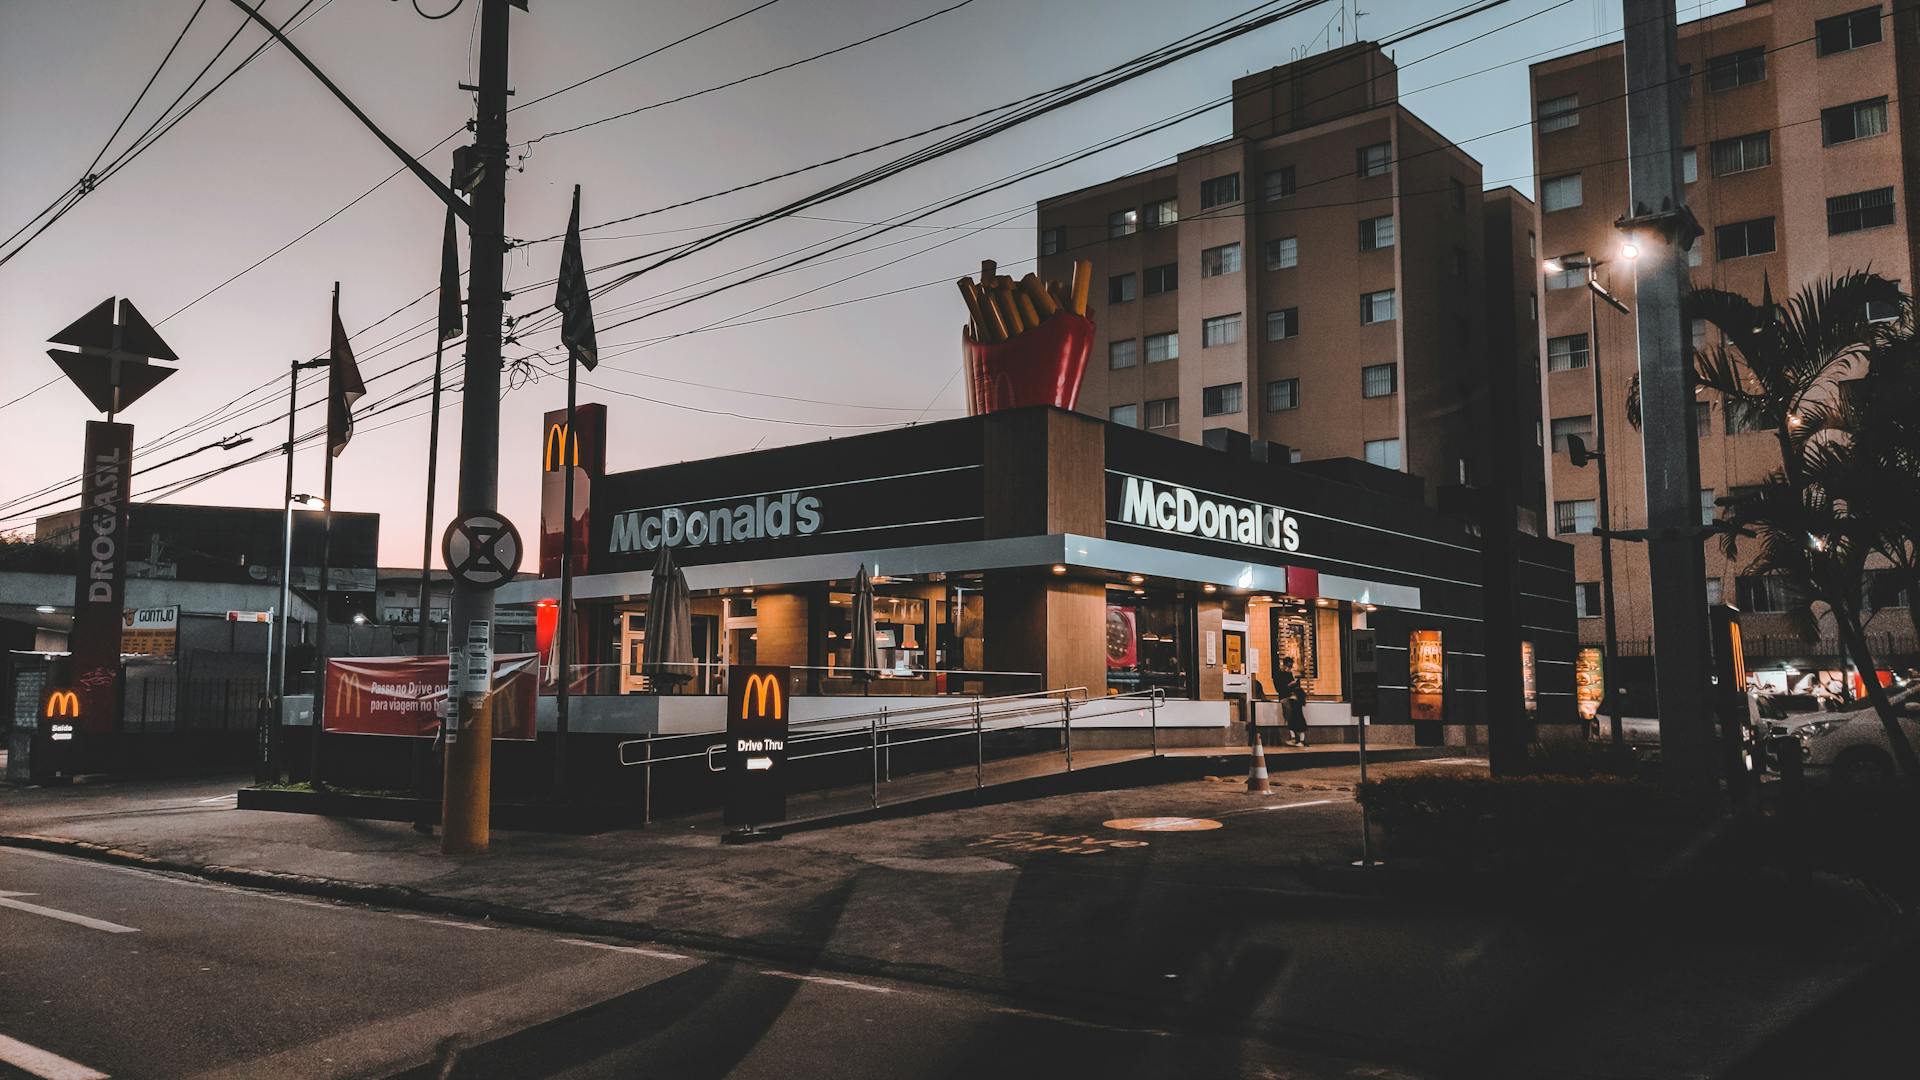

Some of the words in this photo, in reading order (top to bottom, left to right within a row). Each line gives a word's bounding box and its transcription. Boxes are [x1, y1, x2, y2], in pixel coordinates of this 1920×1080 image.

[89, 447, 120, 604] DROGASIL
[608, 492, 821, 553] McDonald's
[1120, 476, 1300, 552] McDonald's
[370, 681, 396, 695] Passe
[396, 683, 408, 694] no
[408, 680, 431, 695] Drive
[370, 700, 388, 714] para
[389, 697, 419, 715] viagem
[420, 700, 433, 712] no
[737, 738, 763, 752] Drive
[763, 738, 784, 752] Thru
